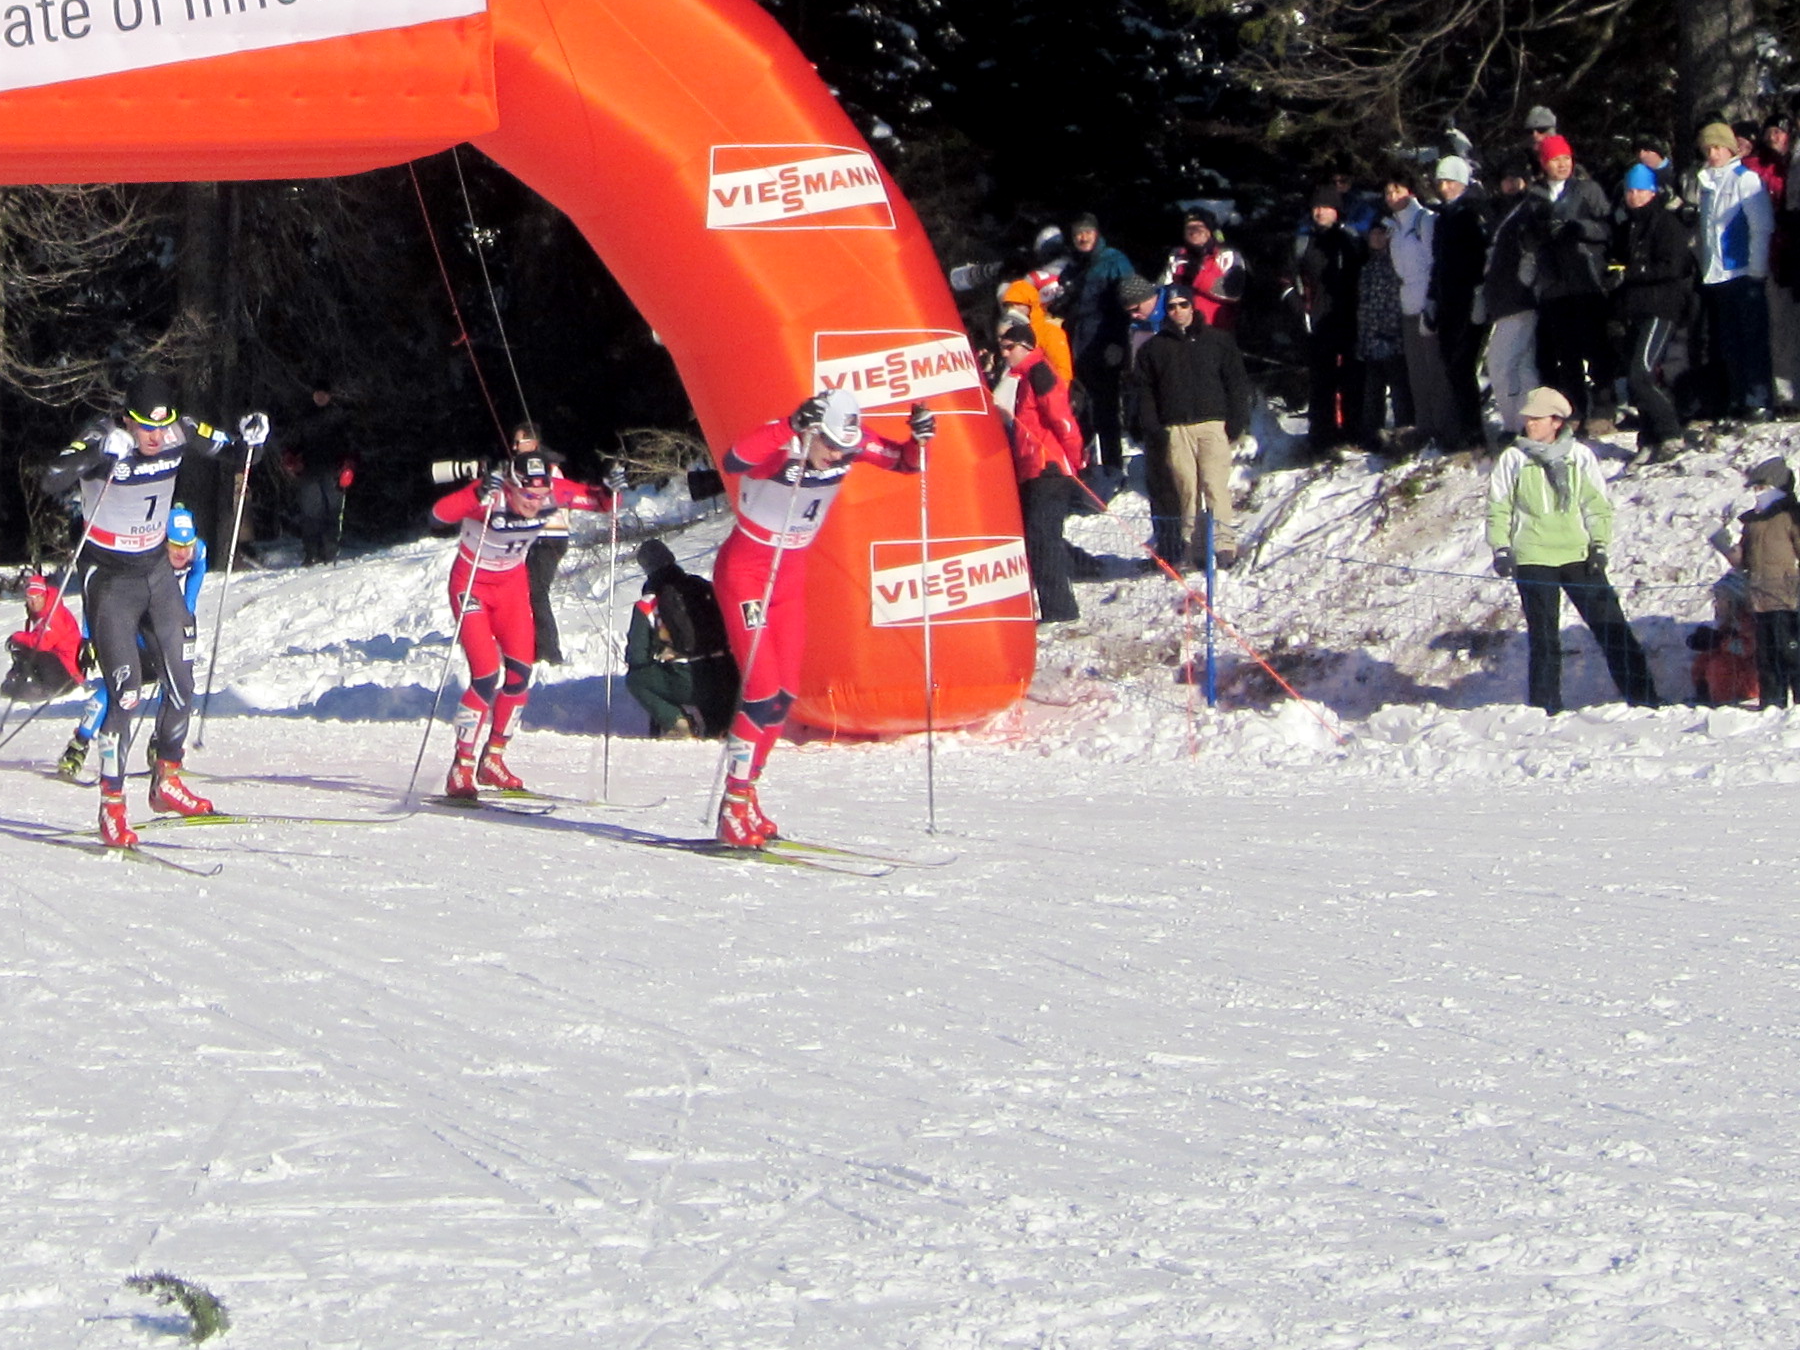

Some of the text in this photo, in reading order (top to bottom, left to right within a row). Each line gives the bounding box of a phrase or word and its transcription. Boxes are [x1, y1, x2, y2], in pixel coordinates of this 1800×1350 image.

[713, 166, 881, 213] VIESSMANN
[143, 494, 159, 523] 7
[802, 499, 821, 522] 4
